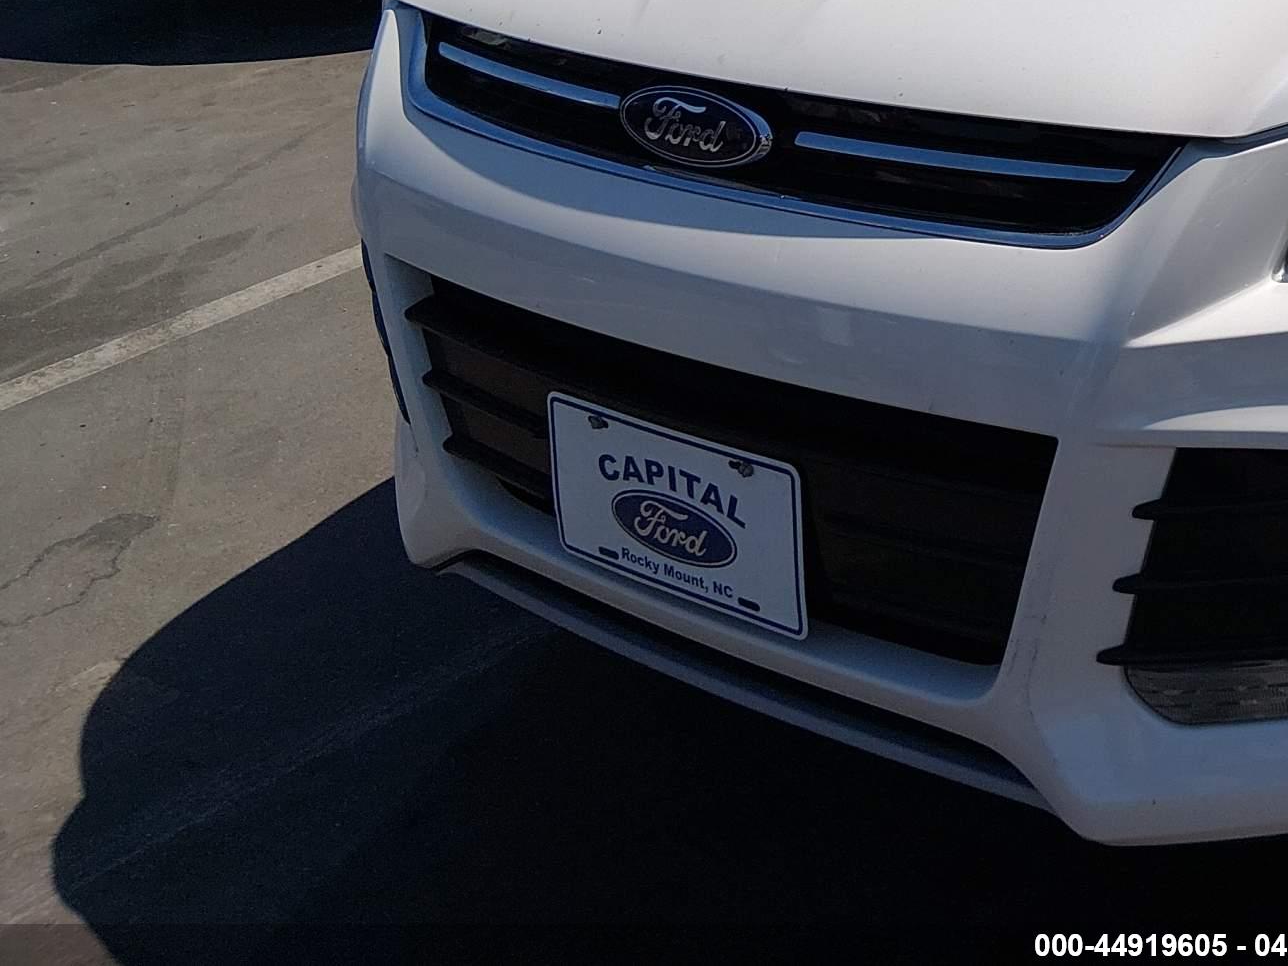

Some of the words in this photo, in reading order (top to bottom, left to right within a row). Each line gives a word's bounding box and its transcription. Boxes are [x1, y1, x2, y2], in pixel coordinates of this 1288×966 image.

[644, 96, 726, 153] Ford
[598, 453, 746, 529] CAPITAL
[633, 499, 708, 557] Ford
[621, 547, 660, 575] Rocky
[663, 563, 709, 593] Mount,
[712, 583, 734, 599] NC
